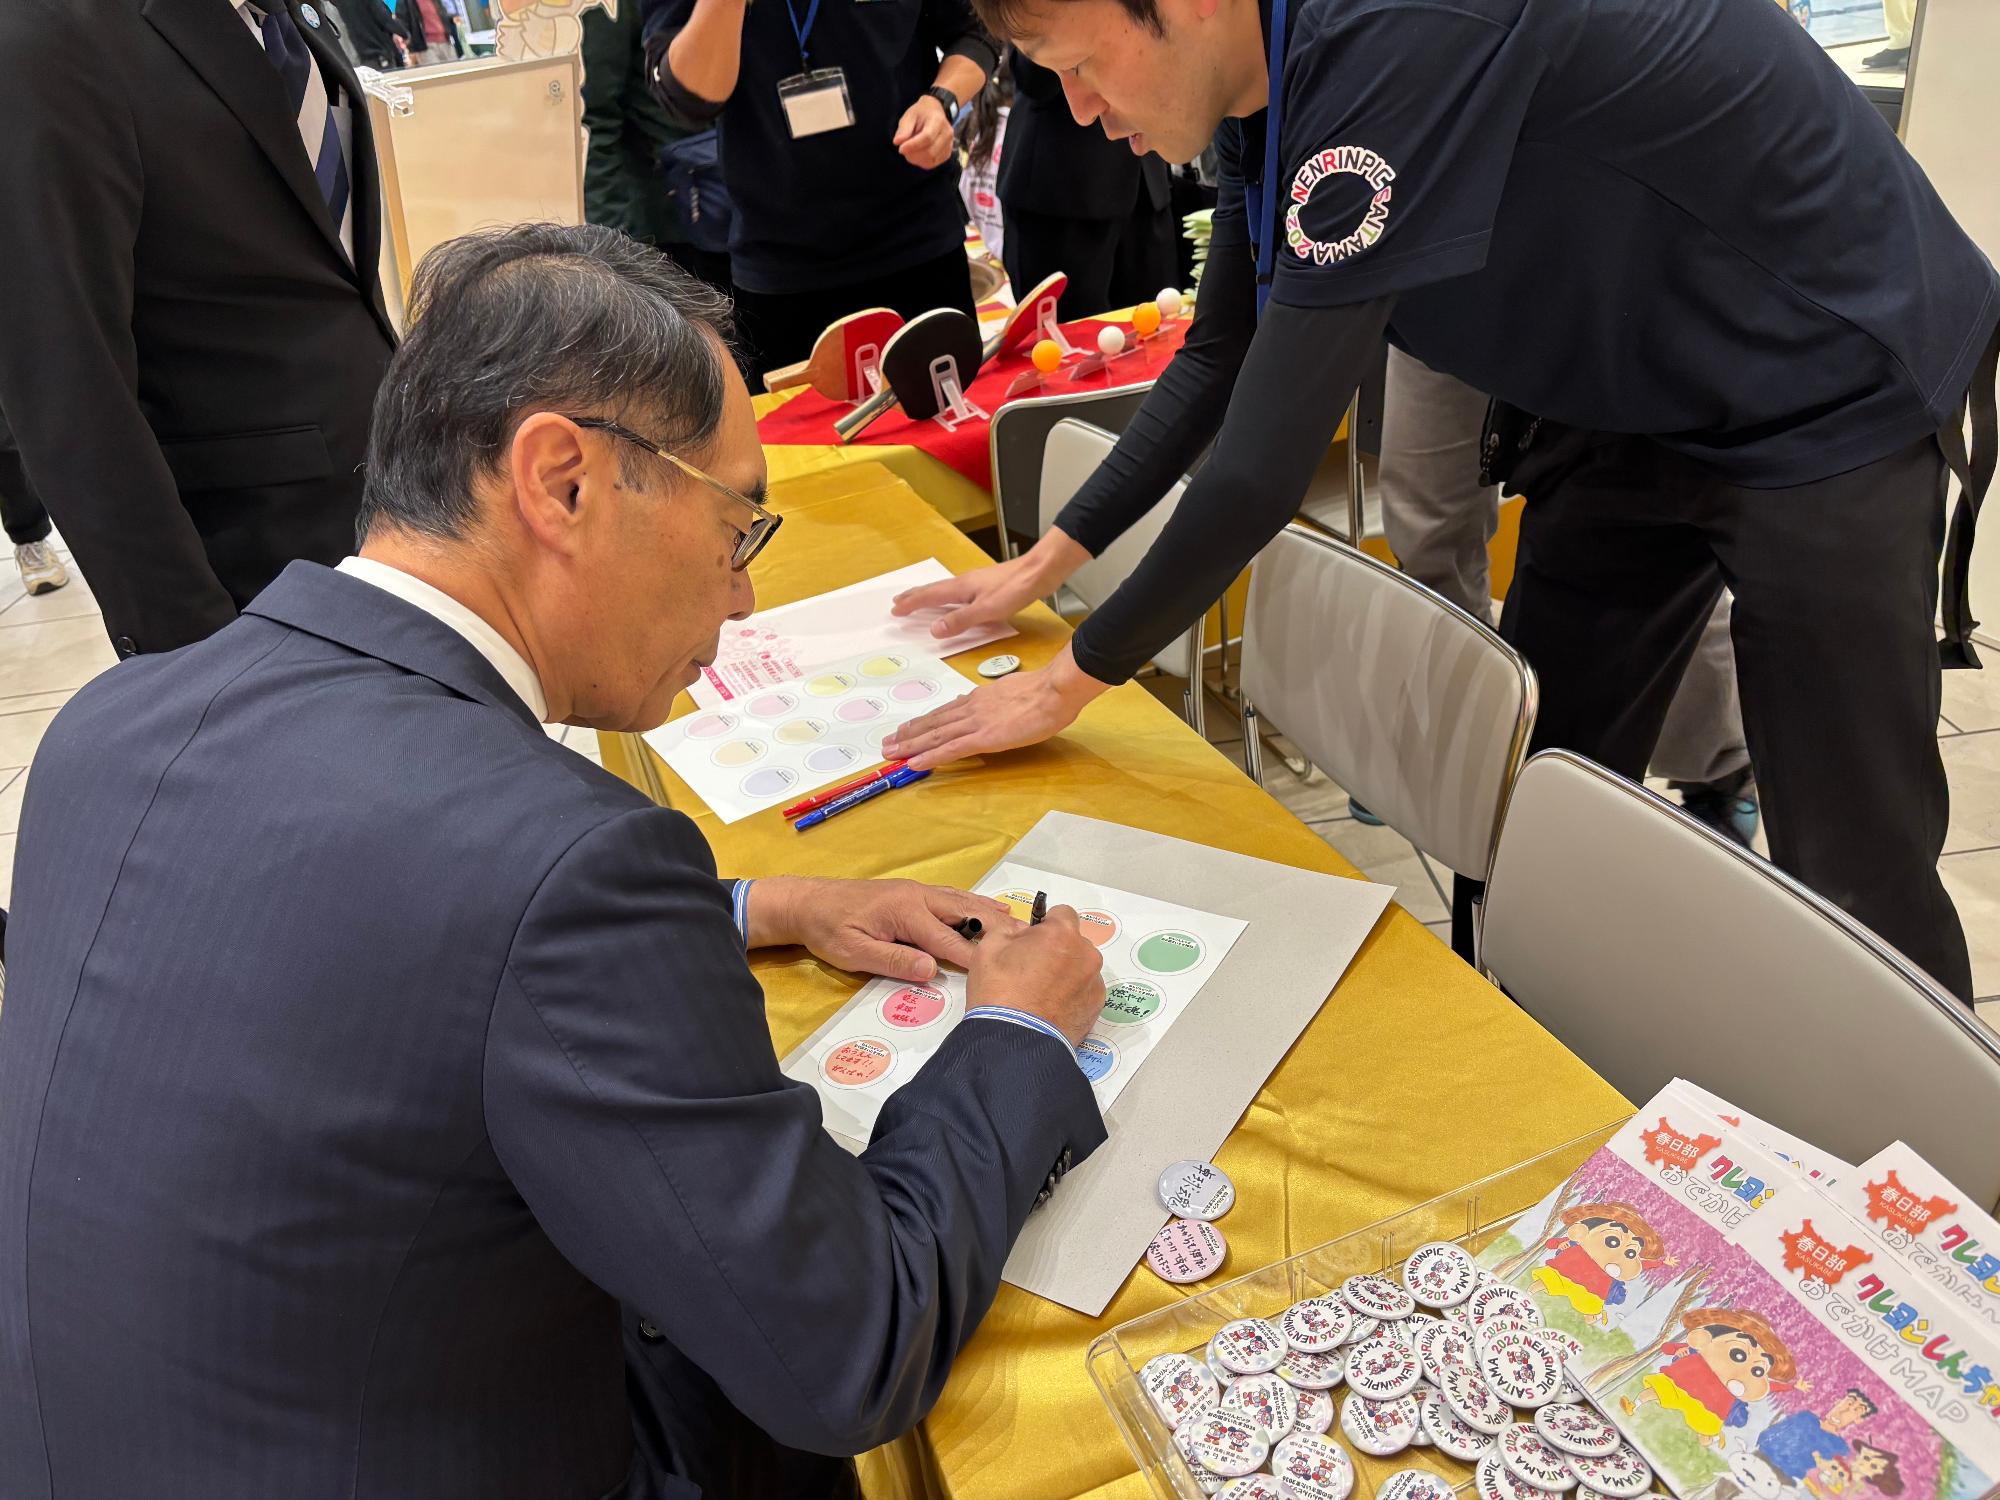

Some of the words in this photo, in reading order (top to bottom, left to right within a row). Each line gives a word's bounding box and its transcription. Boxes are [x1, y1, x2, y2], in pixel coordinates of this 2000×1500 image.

[1292, 147, 1395, 204] NENRINPIC
[1315, 187, 1390, 264] SAITAMA
[1655, 1131, 1700, 1159] 春日部
[1167, 1165, 1216, 1208] 卓球魂
[1880, 1186, 1932, 1222] 春日部
[1408, 1248, 1444, 1289] NENRINPIC
[1796, 1235, 1847, 1272] 春日部
[1448, 1251, 1470, 1294] SAITAMA
[1300, 1300, 1345, 1319] SAITAMA
[1348, 1281, 1393, 1311] NENRINPIC
[1420, 1287, 1449, 1300] 2026
[1473, 1287, 1518, 1324] NENRINPIC
[1320, 1322, 1344, 1342] 2026
[1388, 1341, 1413, 1359] 2026
[1492, 1334, 1519, 1355] 2026
[1351, 1340, 1383, 1377] SAITAMA
[1361, 1361, 1415, 1391] NENRINPIC
[1523, 1336, 1556, 1395] NENRINPIC
[1447, 1371, 1478, 1418] SAITAMA
[1488, 1357, 1534, 1399] SAITAMA
[1428, 1403, 1467, 1448] SAITAMA
[1505, 1428, 1520, 1452] 2026
[1515, 1455, 1572, 1481] SAITAMA
[1602, 1461, 1644, 1487] SAITAMA
